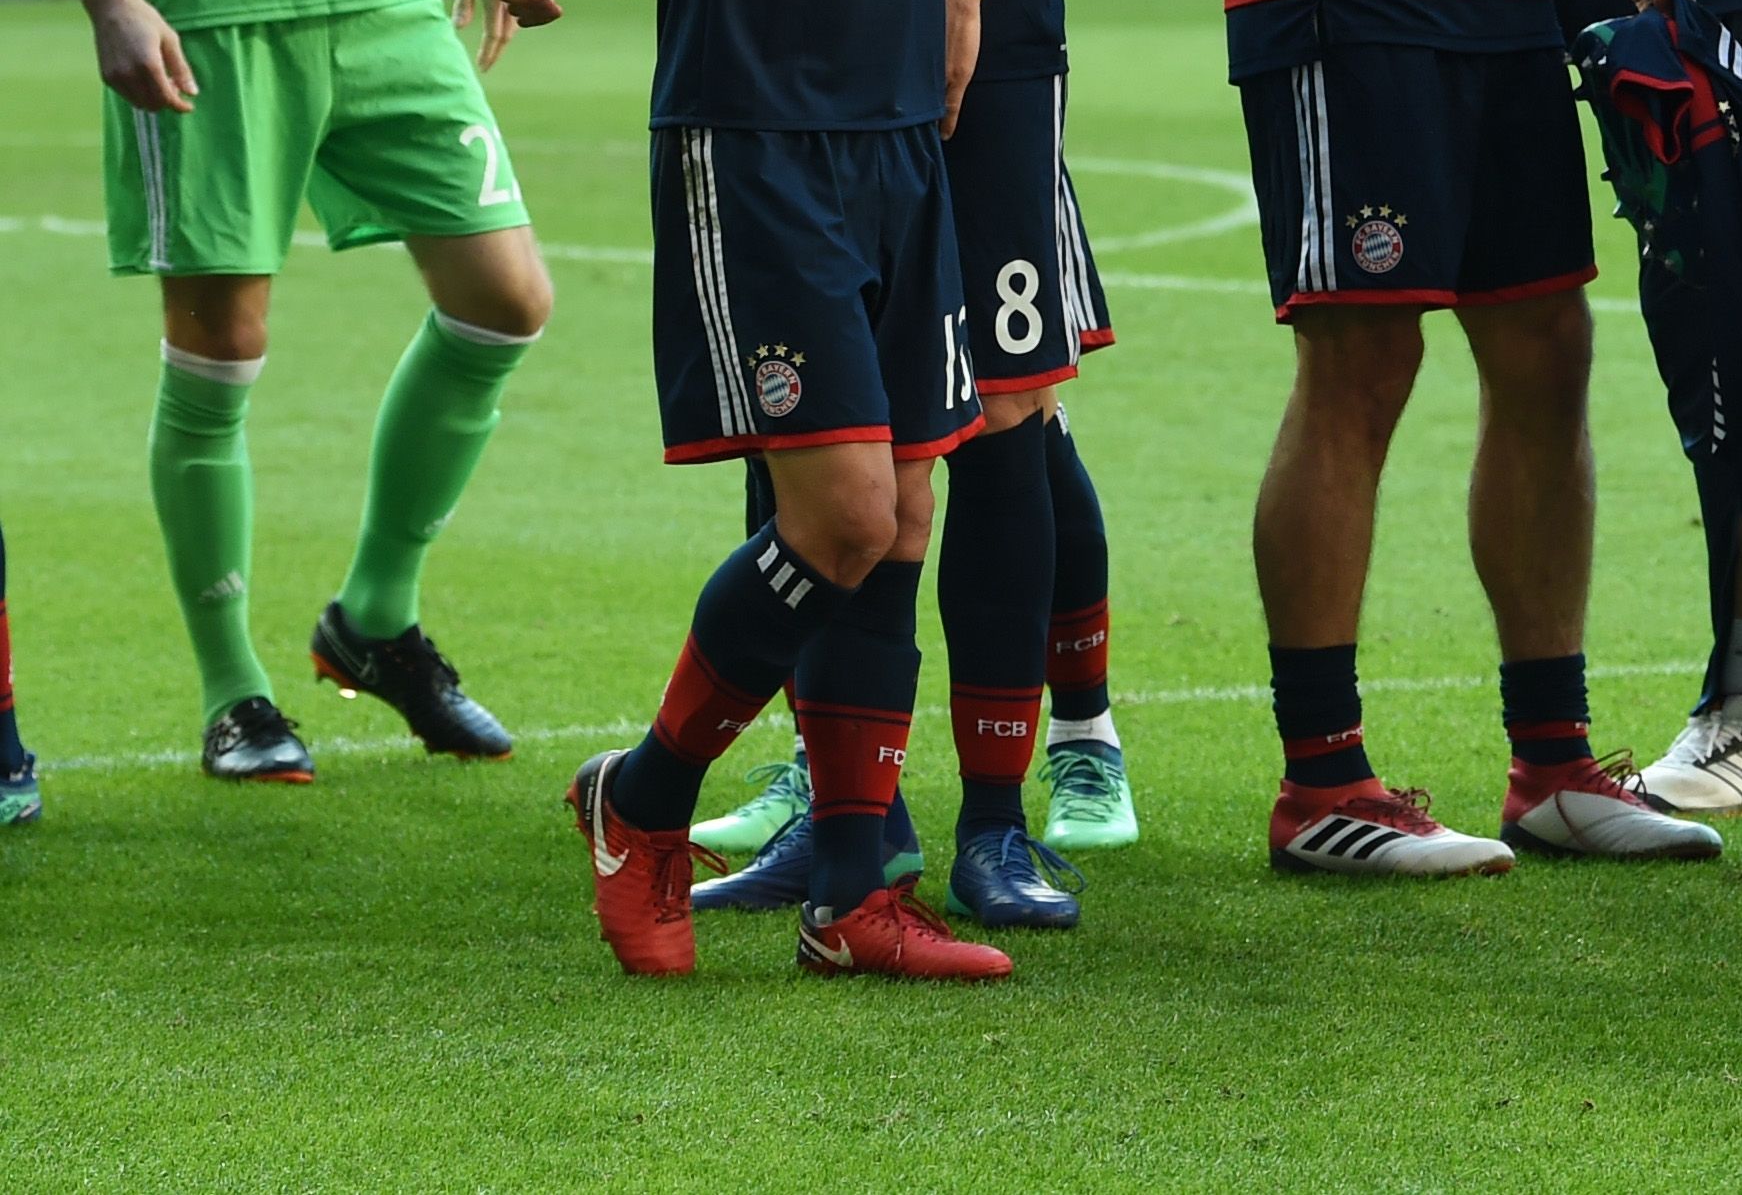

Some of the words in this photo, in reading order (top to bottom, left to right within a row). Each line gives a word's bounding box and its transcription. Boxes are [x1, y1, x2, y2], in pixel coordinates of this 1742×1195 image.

[994, 259, 1043, 355] 8
[1056, 629, 1105, 654] FCB
[977, 718, 1028, 737] FCB
[878, 745, 906, 766] FC
